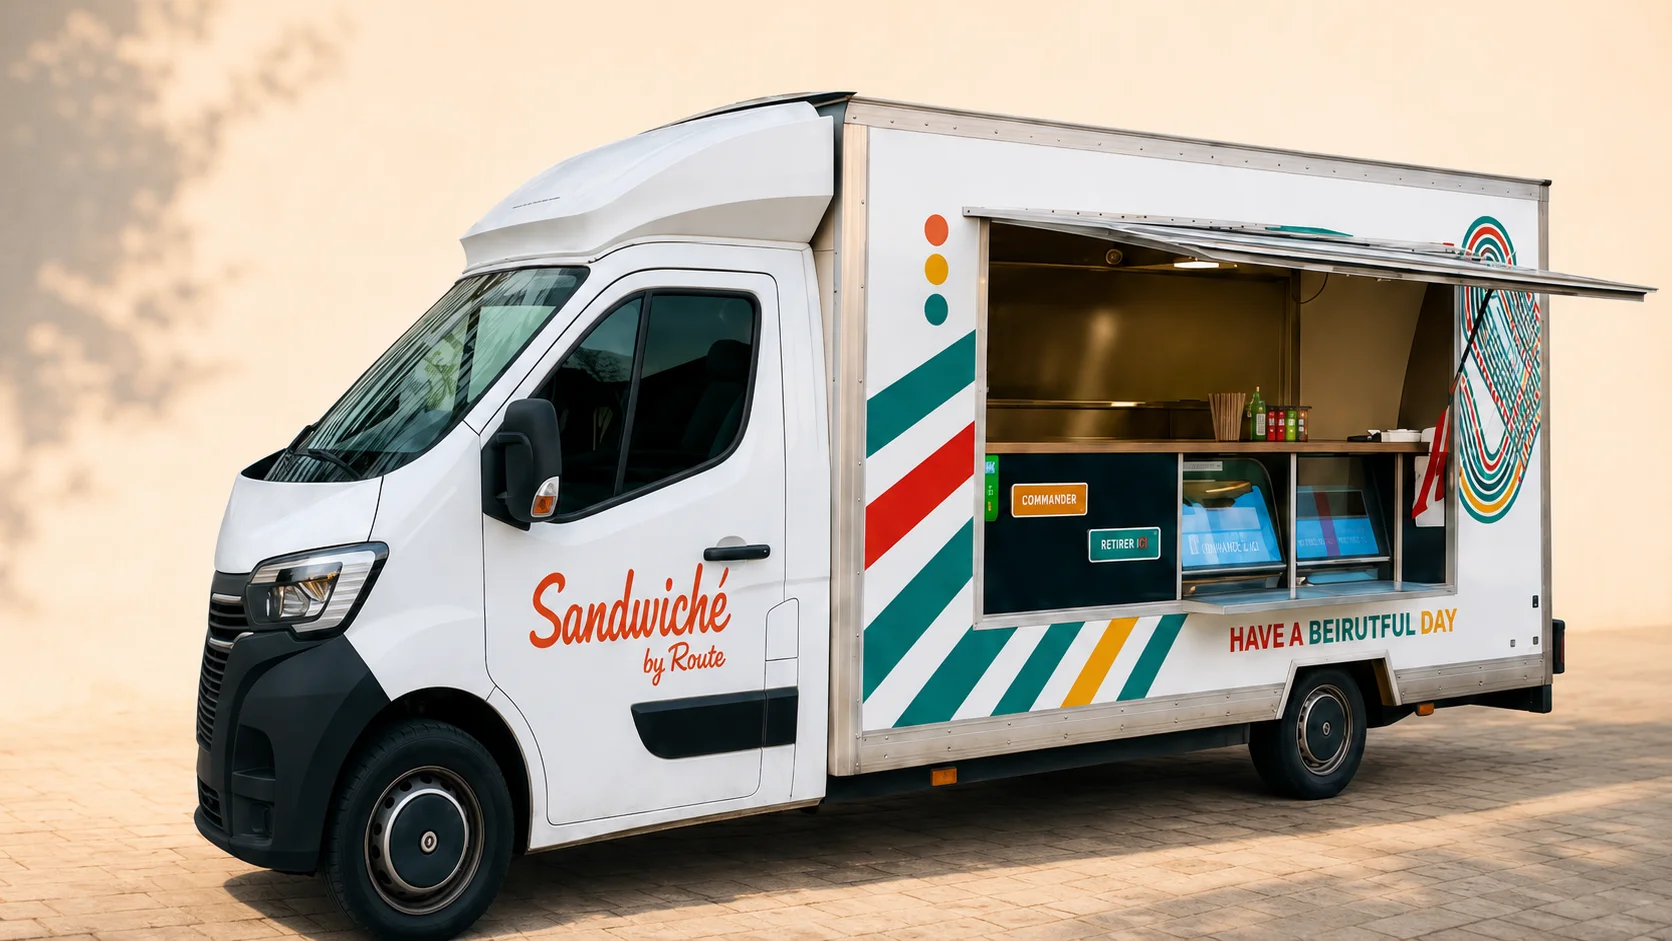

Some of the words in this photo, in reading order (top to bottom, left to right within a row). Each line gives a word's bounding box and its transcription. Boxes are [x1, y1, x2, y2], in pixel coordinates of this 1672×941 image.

[1022, 494, 1077, 506] COMMANDER
[1101, 538, 1135, 550] RETIRER
[1136, 537, 1149, 549] ICI
[529, 562, 732, 649] Sandwiché
[1230, 624, 1284, 652] HAVE
[1289, 622, 1303, 646] A
[1309, 612, 1416, 645] BEIRUTFUL
[1421, 608, 1457, 635] DAY
[643, 647, 666, 687] by
[668, 641, 727, 672] Route
